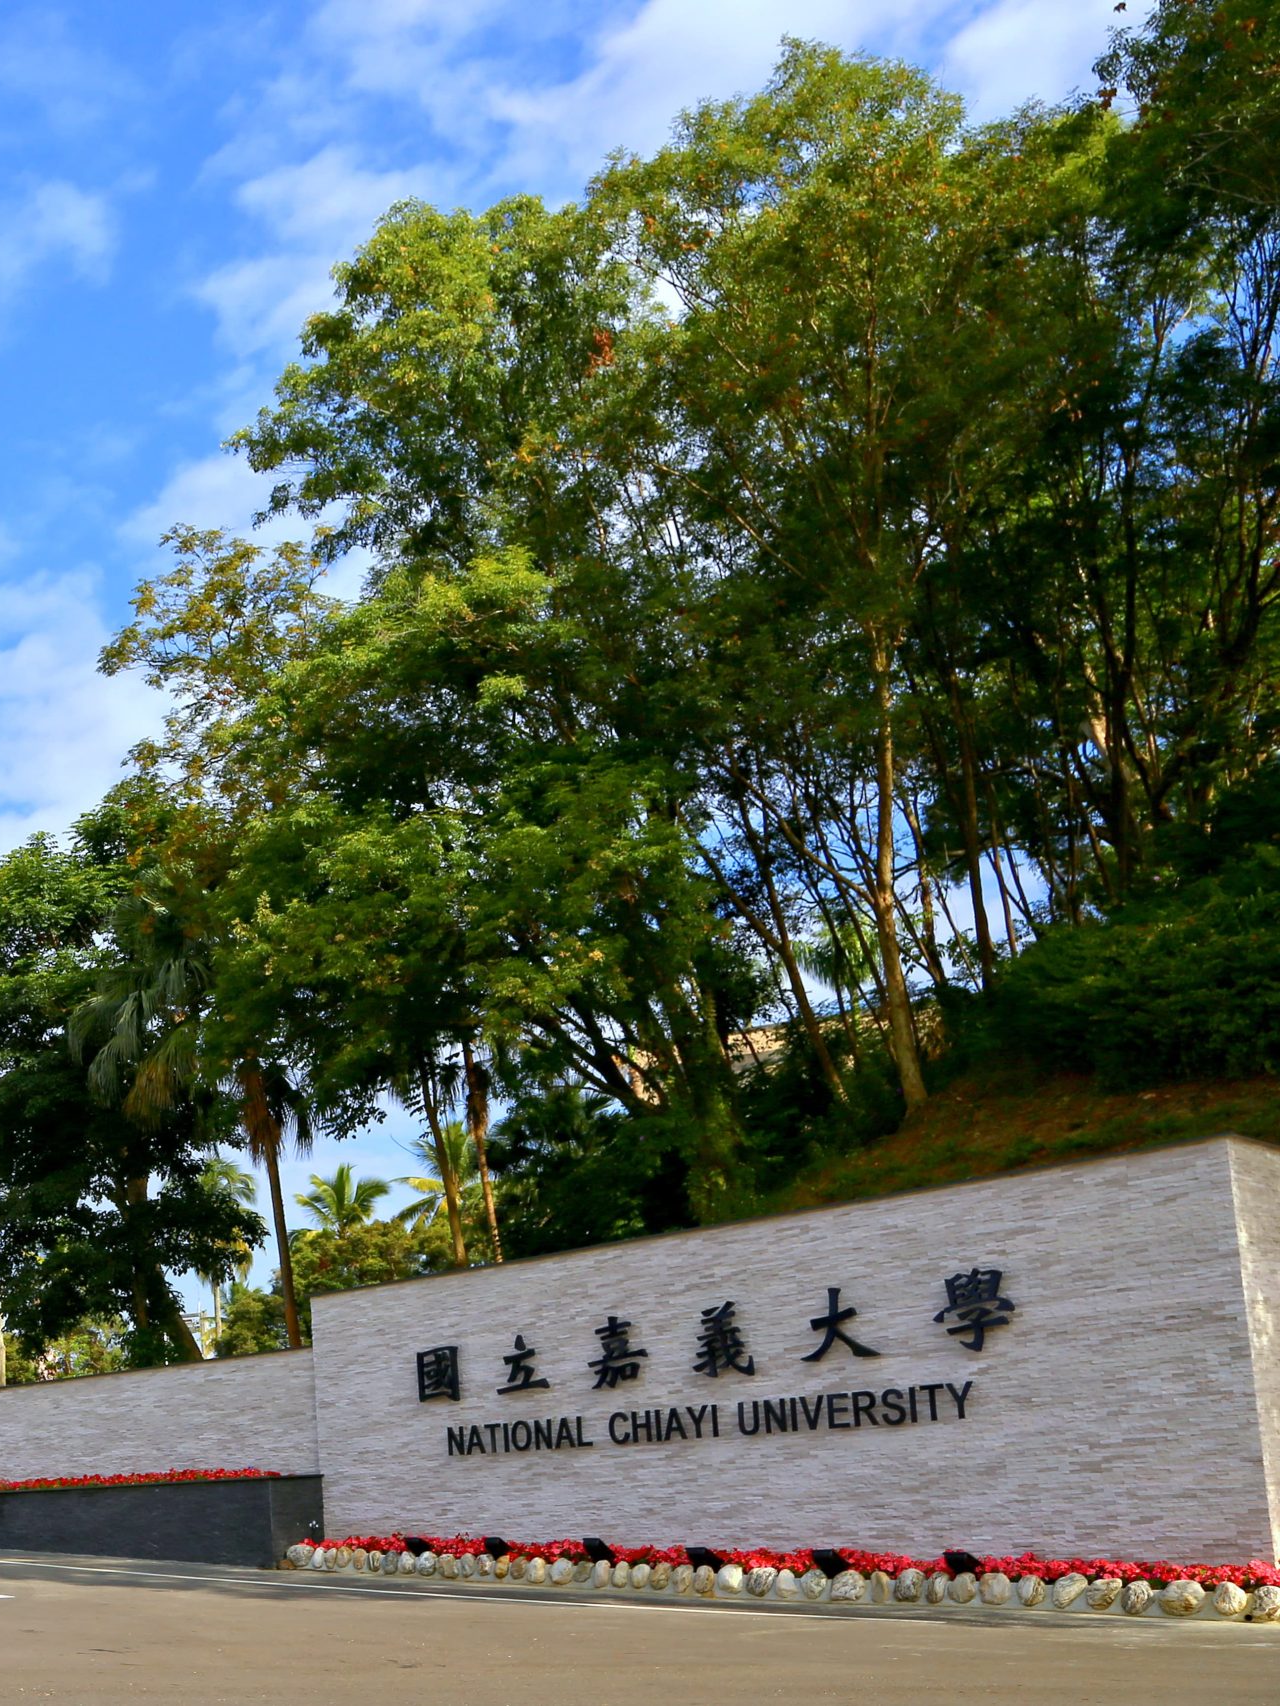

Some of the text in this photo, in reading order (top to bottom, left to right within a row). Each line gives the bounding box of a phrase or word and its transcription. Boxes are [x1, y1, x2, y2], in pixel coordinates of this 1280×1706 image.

[416, 1267, 1014, 1402] 國立嘉義大學
[447, 1381, 973, 1456] NATIONAL CHIAYI UNIVERSITY
